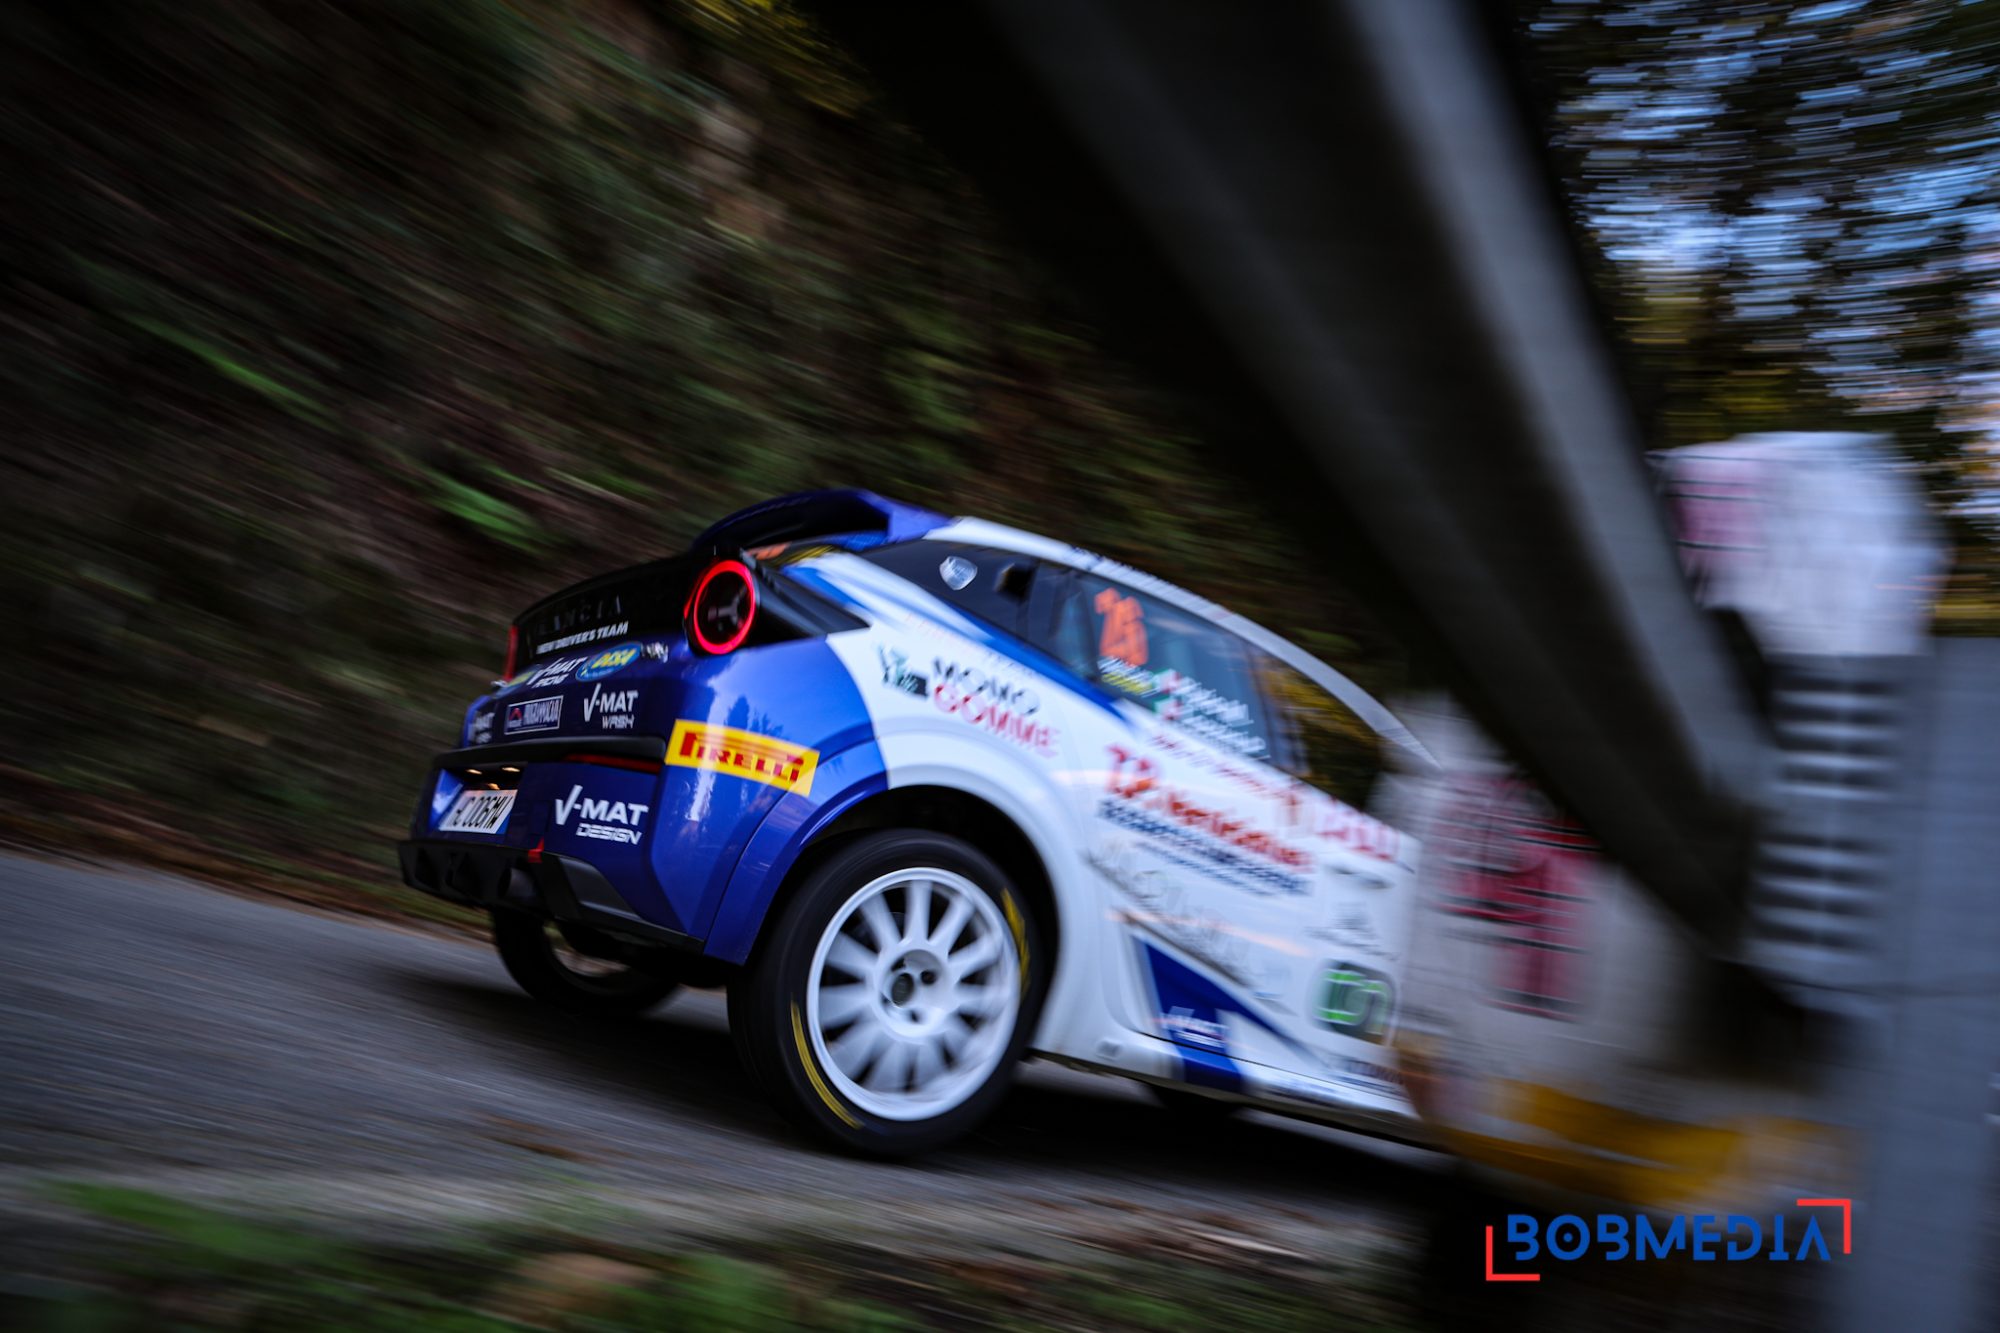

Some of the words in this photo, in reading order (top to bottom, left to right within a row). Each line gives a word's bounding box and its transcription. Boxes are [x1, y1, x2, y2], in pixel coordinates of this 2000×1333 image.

[597, 621, 629, 640] TEAM
[583, 683, 639, 723] V-MAT
[680, 732, 804, 783] PIRELLI
[555, 784, 649, 826] V-MAT
[576, 823, 643, 845] DESIGN
